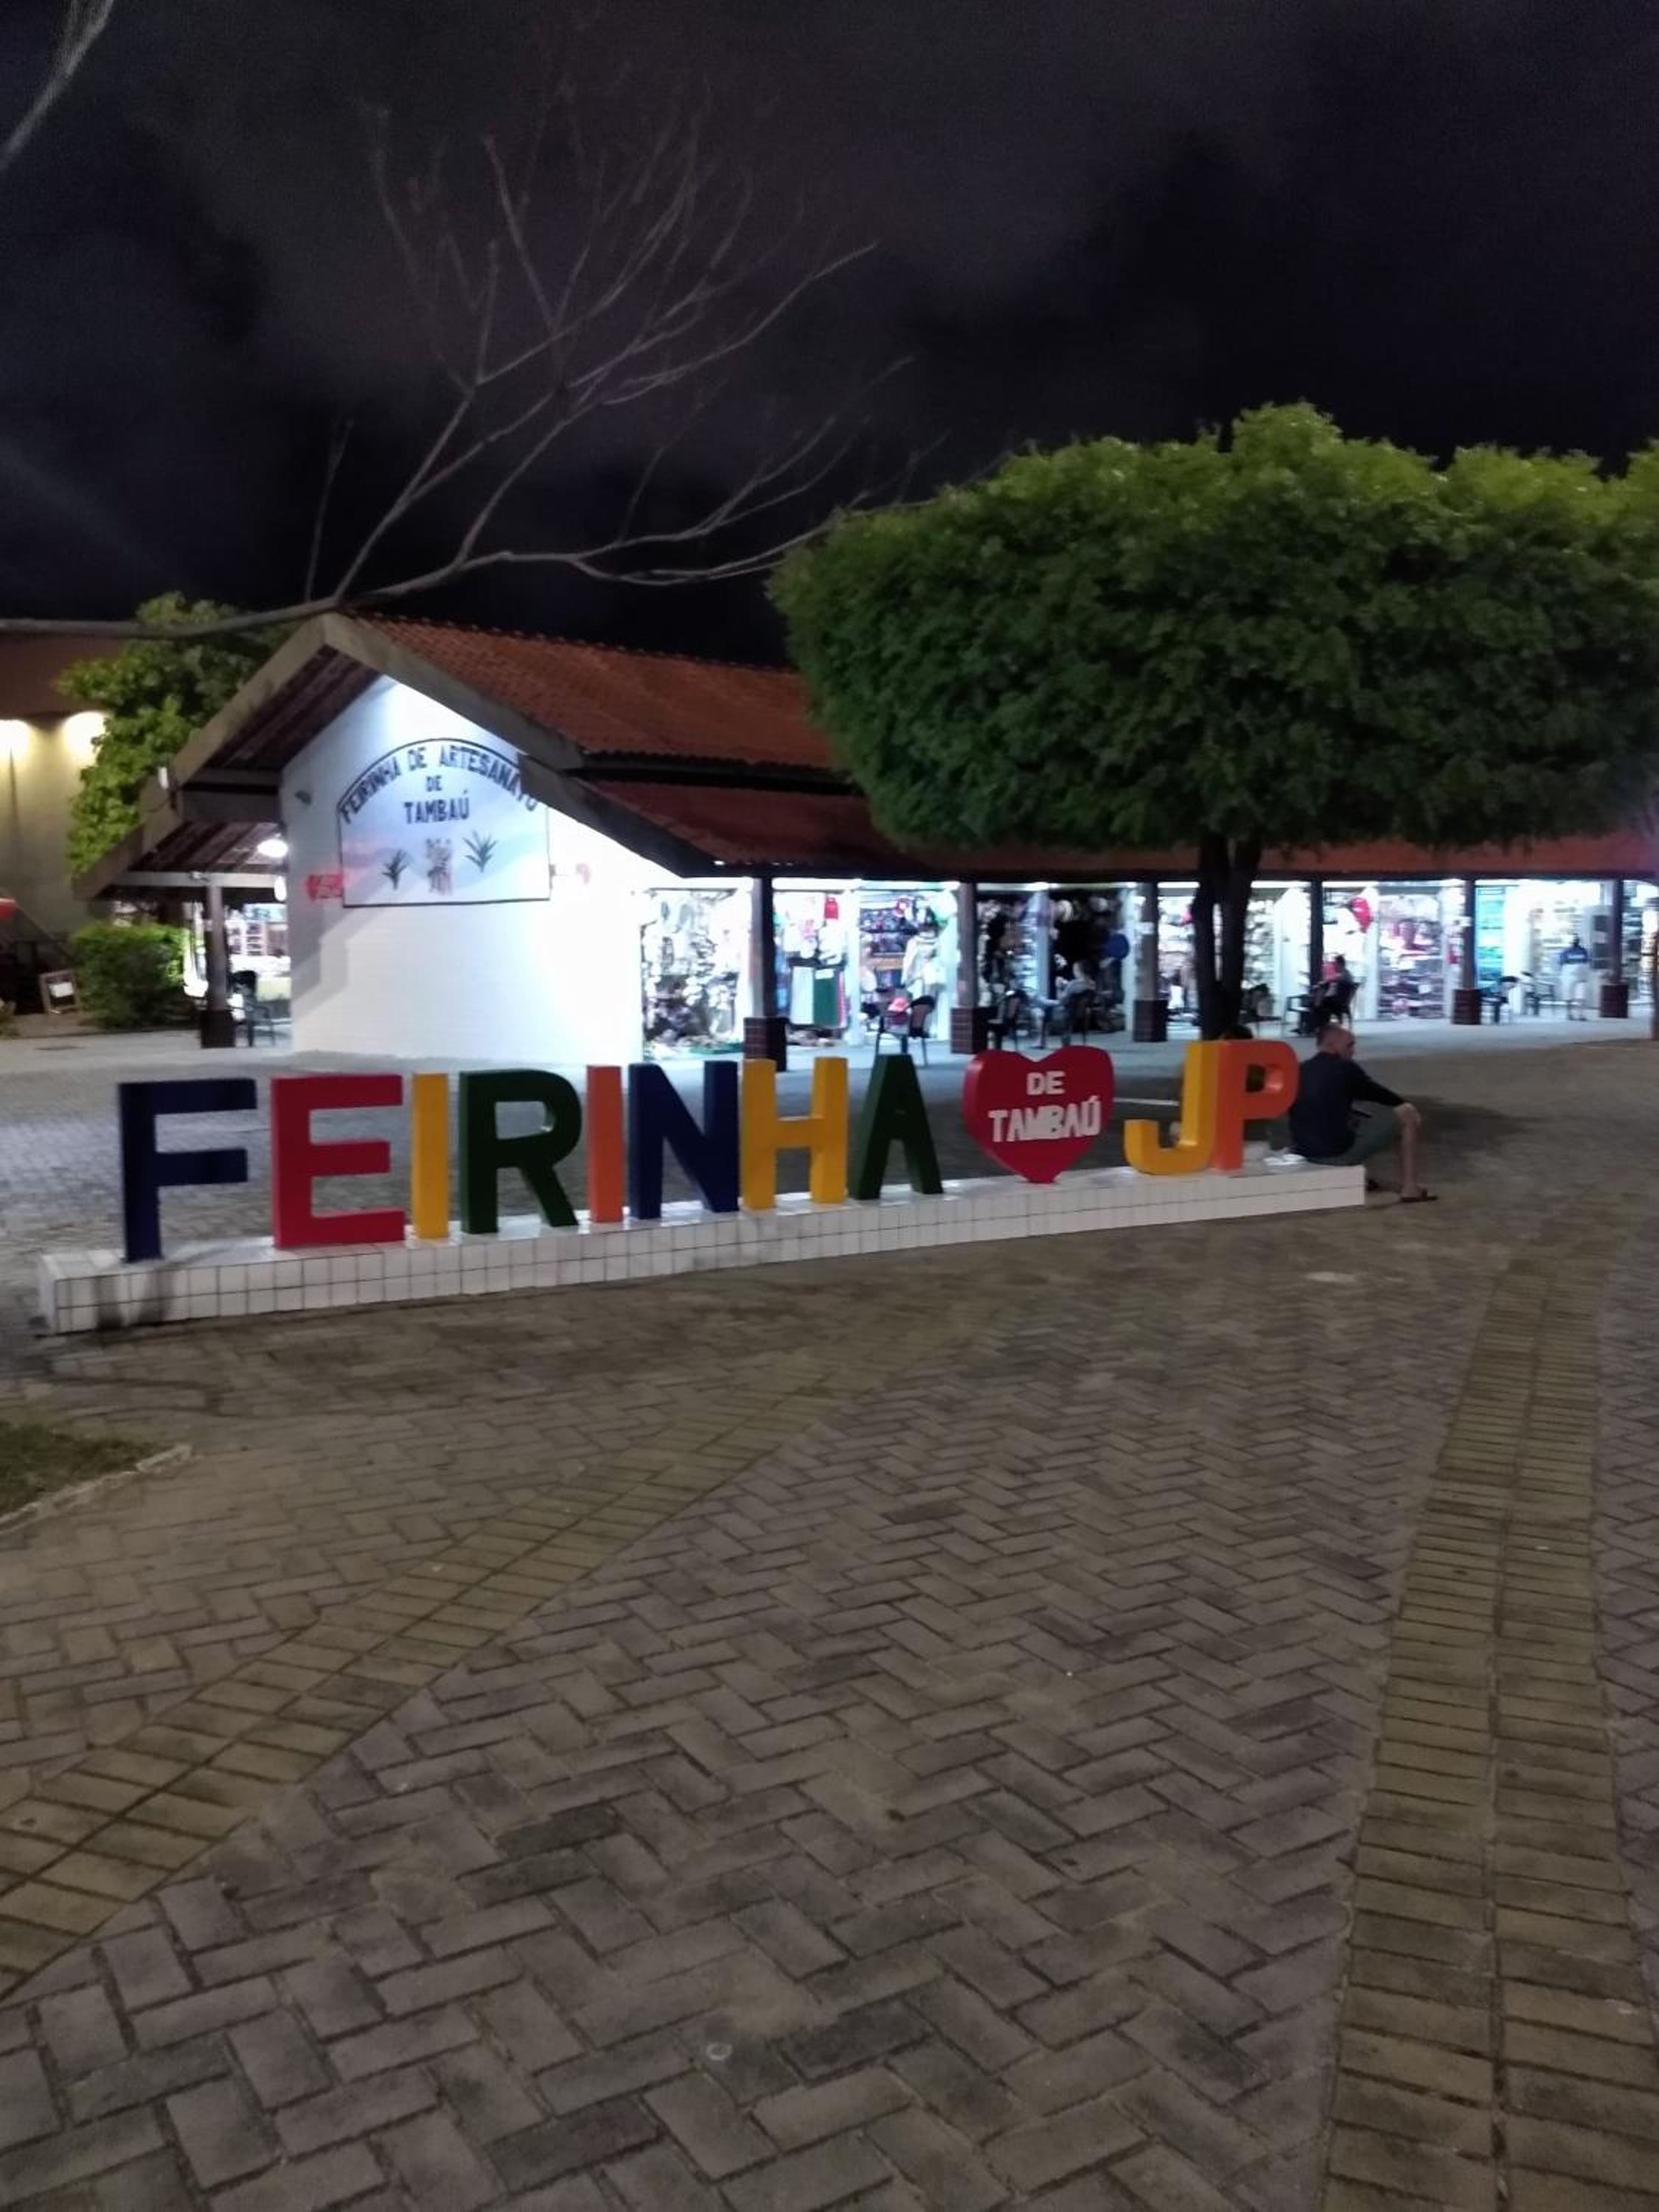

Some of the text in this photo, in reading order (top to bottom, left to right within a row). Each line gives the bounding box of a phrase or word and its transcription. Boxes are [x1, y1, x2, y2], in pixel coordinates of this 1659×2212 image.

[340, 745, 538, 824] FEIRINHA DE ARTESANAO
[426, 775, 442, 792] DE
[404, 789, 470, 824] TAMBAÚ
[1026, 1071, 1065, 1096] DE
[988, 1095, 1101, 1143] TAMBAÚ
[119, 1040, 1298, 1262] FEIRINHA JP
